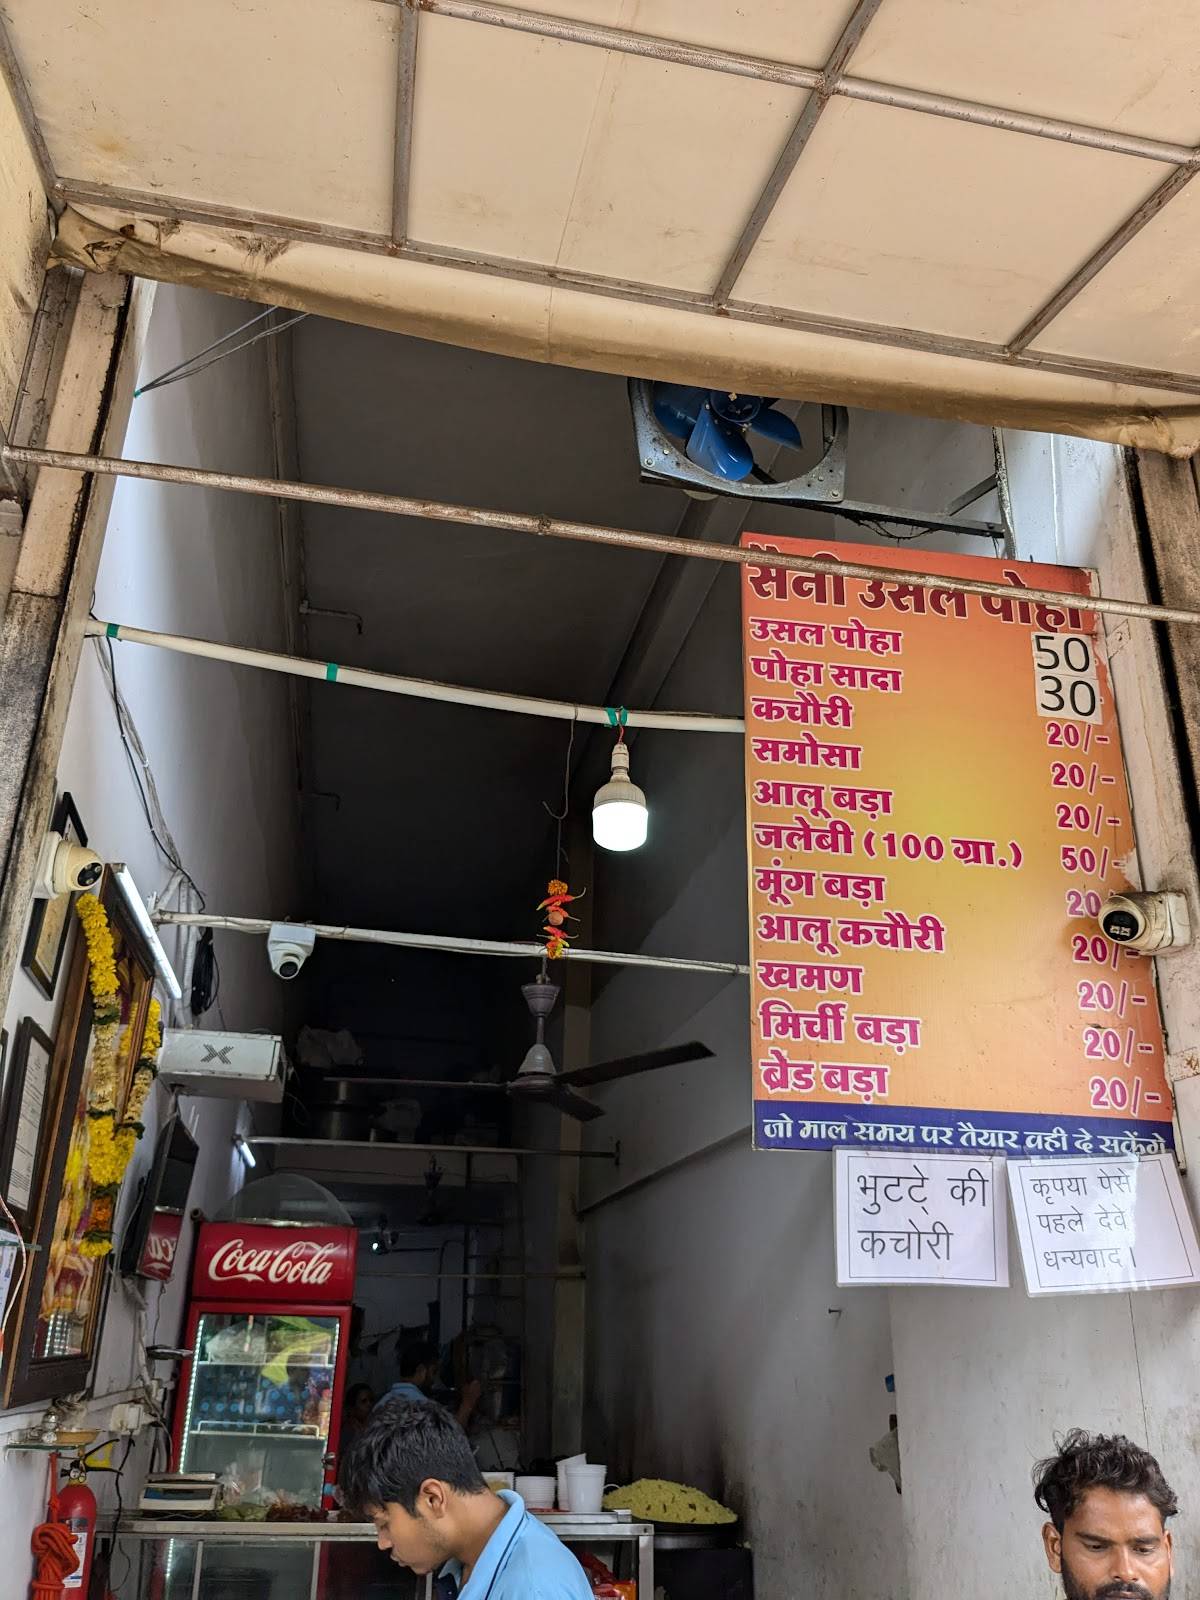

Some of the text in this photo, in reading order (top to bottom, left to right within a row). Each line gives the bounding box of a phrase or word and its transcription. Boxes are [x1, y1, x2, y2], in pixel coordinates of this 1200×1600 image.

[750, 617, 902, 655] उसल पोहा
[1034, 634, 1090, 673] 50
[750, 649, 902, 693] पोहा सादा
[752, 690, 853, 728] कचौरी
[1040, 675, 1096, 717] 30
[752, 732, 862, 770] समोसा
[1047, 722, 1109, 753] 20/-
[1051, 762, 1115, 794] 20/-
[754, 780, 893, 821] आलू बड़ा
[1056, 803, 1121, 836] 20/-
[754, 815, 855, 855] जलेबी
[756, 859, 885, 908] मूंग बड़ा
[758, 911, 945, 955] आलू कचौरी
[758, 961, 864, 994] खमण
[1078, 981, 1147, 1017] 20/-
[759, 999, 921, 1053] मिर्ची बड़ा
[1084, 1029, 1154, 1066] 20/-
[760, 1049, 889, 1103] ब्रेड बड़ा
[1090, 1078, 1161, 1115] 20/-
[763, 1113, 1167, 1155] जो माल समय पर तैयार वही दे सकेंगे
[946, 1168, 989, 1207] की
[1029, 1176, 1088, 1205] कृपया
[1035, 1205, 1084, 1234] पहले
[857, 1218, 954, 1261] कचोरी
